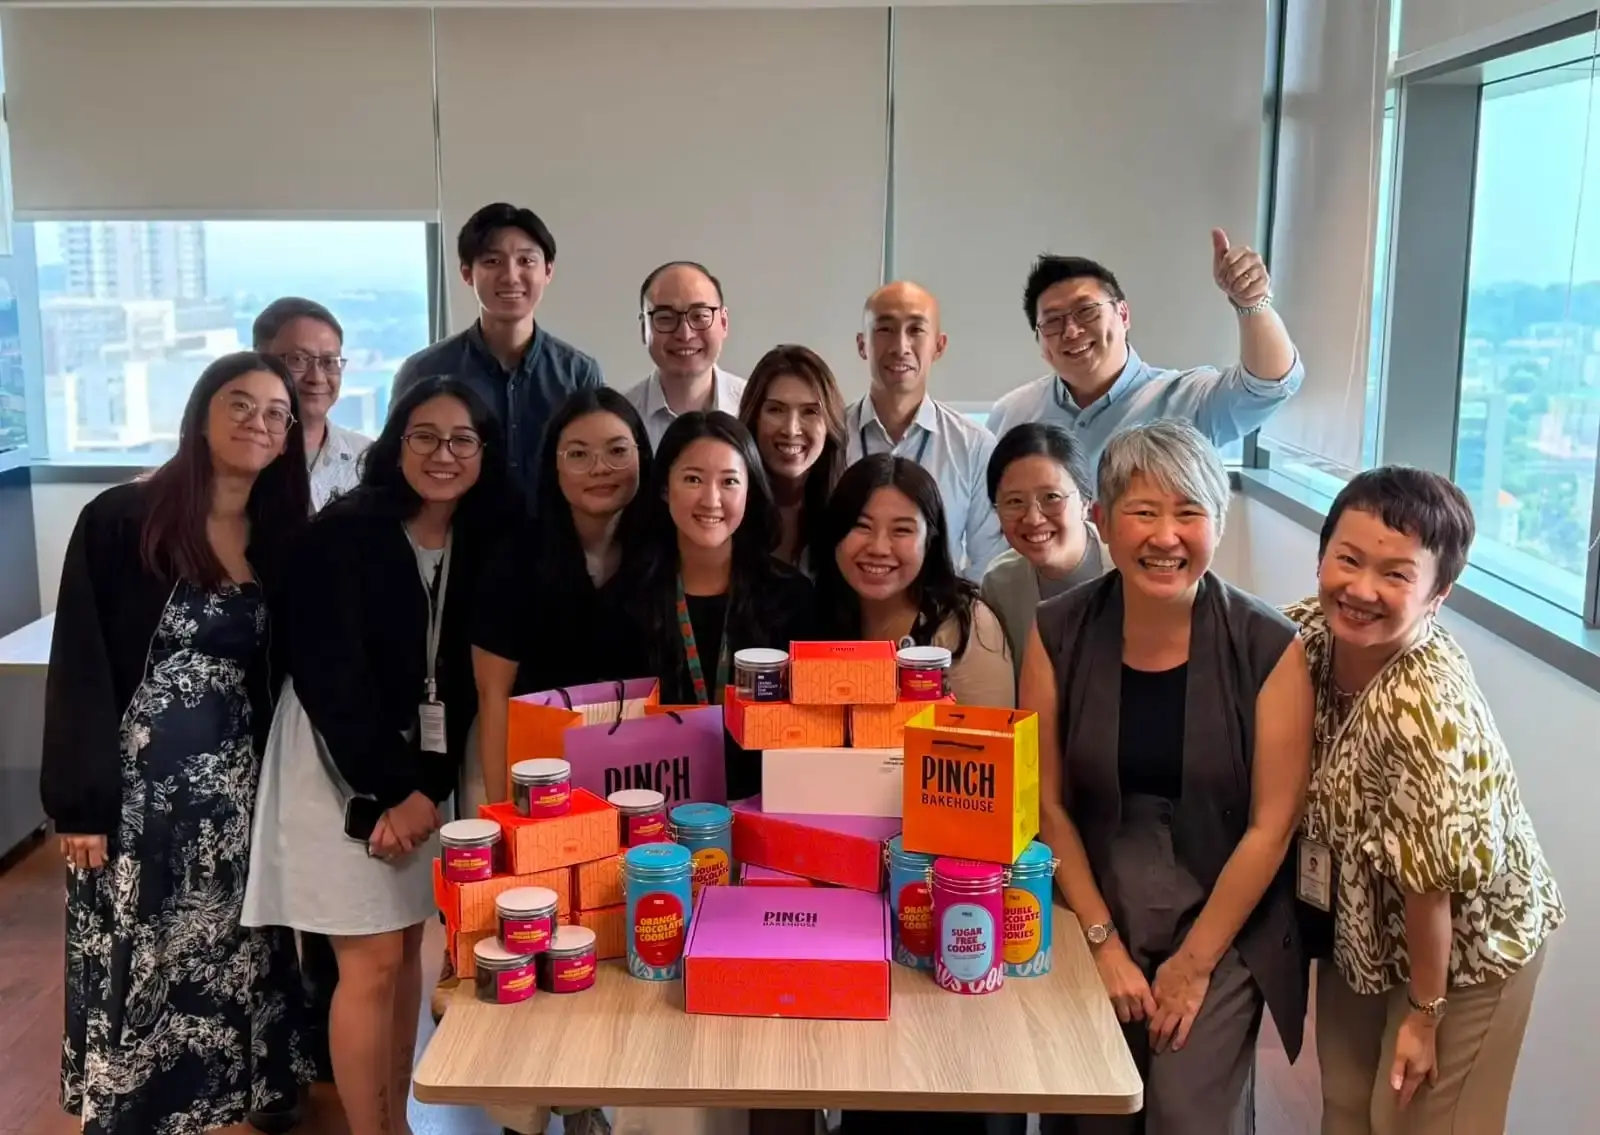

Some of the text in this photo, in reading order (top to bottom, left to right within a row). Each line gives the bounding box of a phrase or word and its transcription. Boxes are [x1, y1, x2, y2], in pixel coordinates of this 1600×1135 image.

[922, 755, 994, 798] PINCH
[922, 793, 994, 813] BAKEHOUSE
[1003, 906, 1033, 915] OUBLE
[640, 913, 677, 926] ORANGE
[764, 911, 817, 923] PINCH
[634, 918, 684, 934] CHOCOLATE
[951, 927, 982, 936] SUGAR
[1004, 923, 1026, 931] CHIP
[640, 929, 678, 941] COOKIES
[956, 936, 978, 944] FREE
[947, 941, 987, 953] COOKIES
